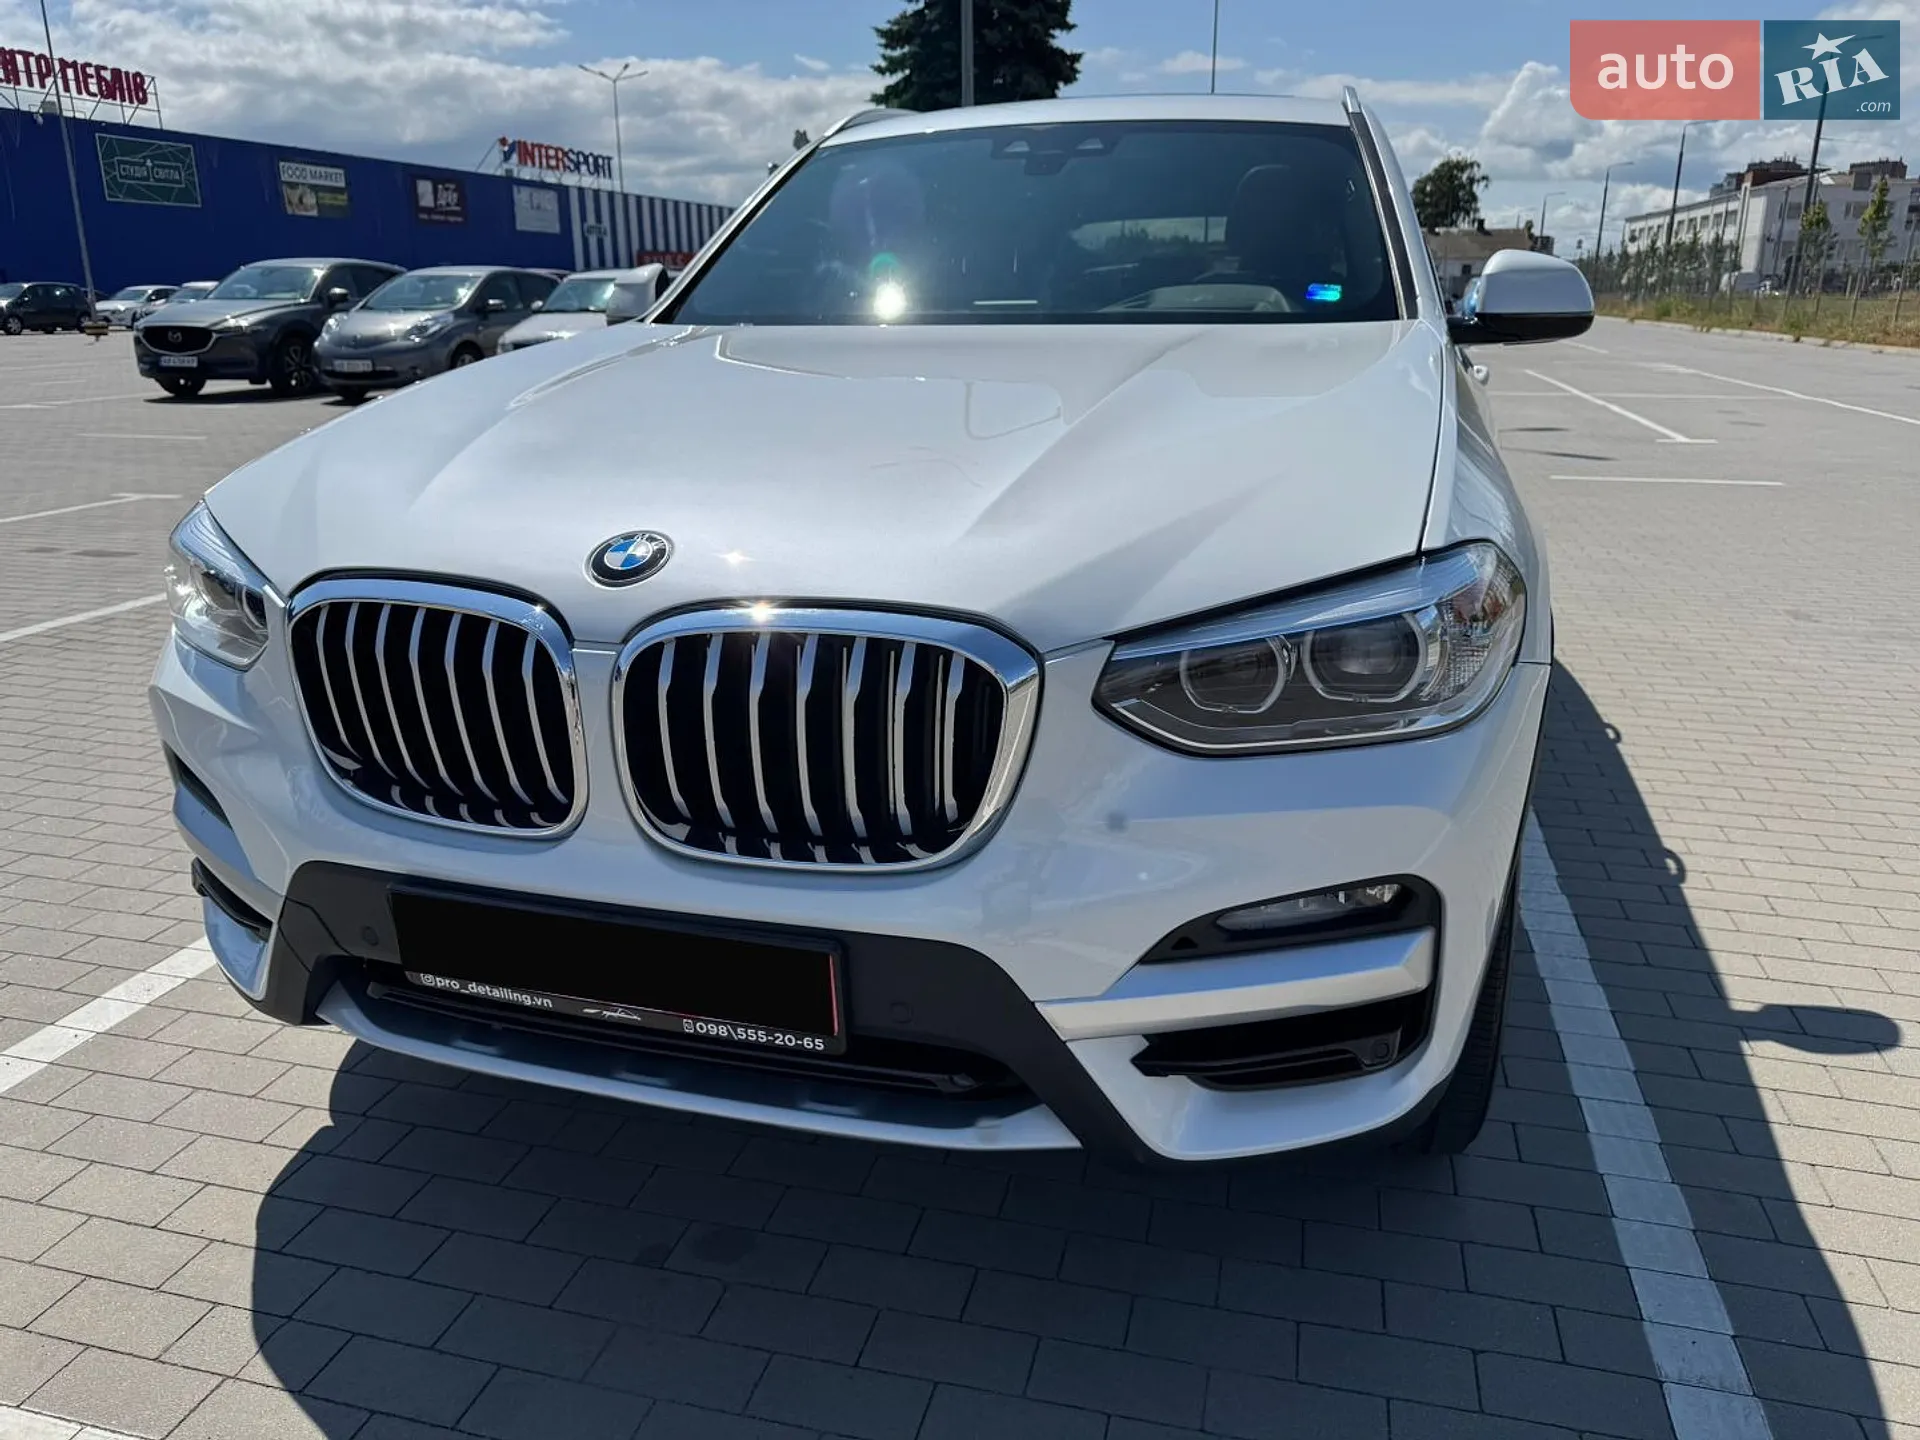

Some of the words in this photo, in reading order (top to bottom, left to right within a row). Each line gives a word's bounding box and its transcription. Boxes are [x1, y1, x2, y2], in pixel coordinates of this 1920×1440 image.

[0, 47, 52, 89] НТР
[58, 57, 148, 105] МЕБЛІВ
[281, 164, 307, 180] FOOD
[309, 168, 344, 184] MARKET
[516, 139, 613, 179] INTERSPORT
